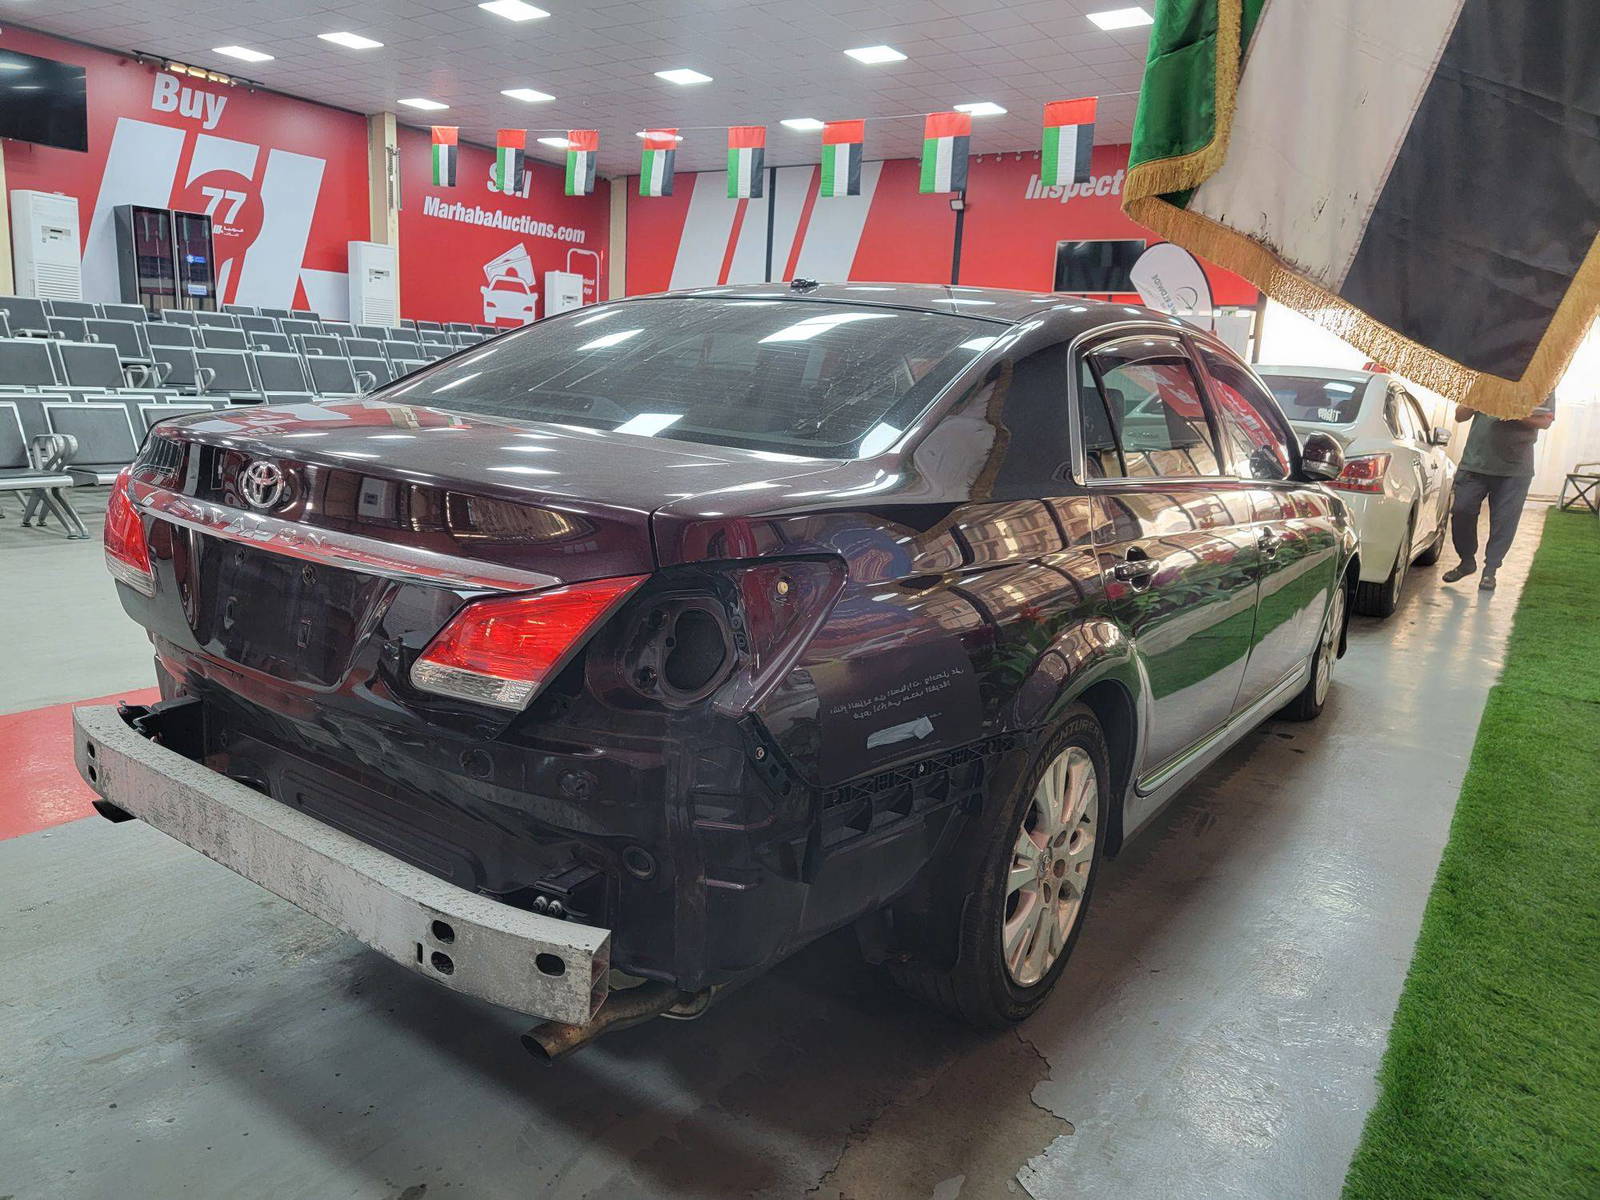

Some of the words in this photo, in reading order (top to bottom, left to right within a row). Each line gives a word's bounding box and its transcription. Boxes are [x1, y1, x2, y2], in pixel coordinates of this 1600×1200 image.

[151, 72, 228, 130] Buy
[202, 186, 247, 225] 77
[423, 195, 586, 244] MarhabaAuctions.com
